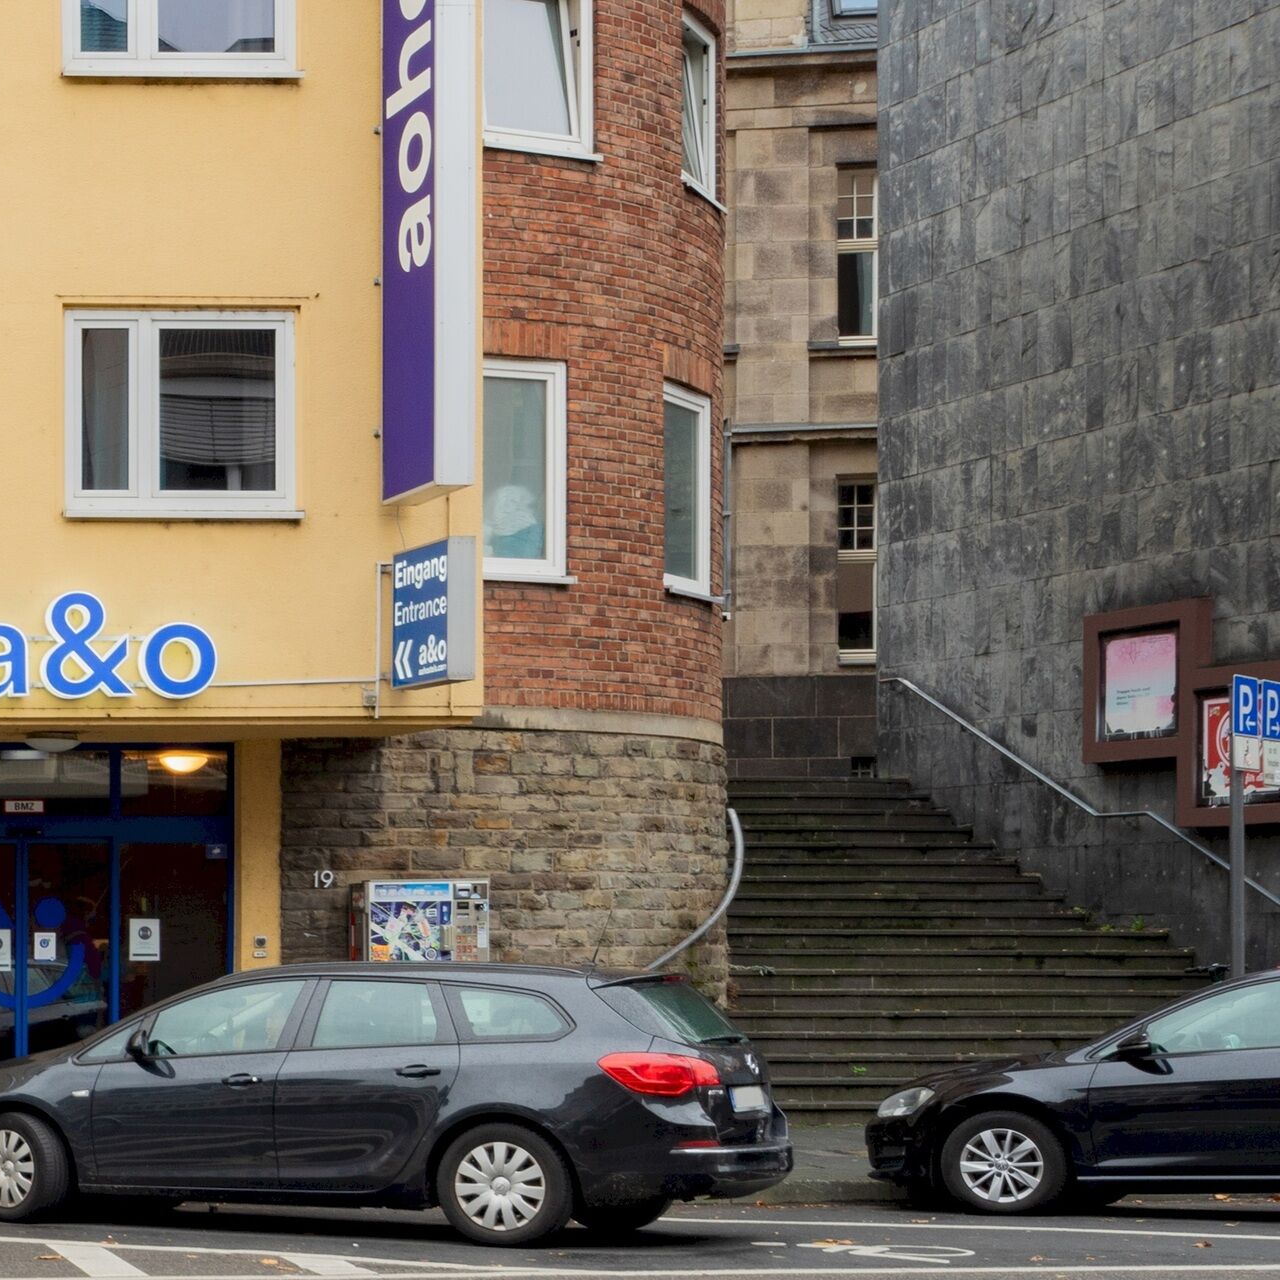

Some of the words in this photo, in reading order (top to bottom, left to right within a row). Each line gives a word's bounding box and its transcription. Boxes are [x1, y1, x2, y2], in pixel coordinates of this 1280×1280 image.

[394, 554, 448, 590] Eingang
[394, 595, 448, 627] Entrance
[418, 634, 447, 665] a&o
[14, 802, 35, 811] BMZ
[313, 870, 334, 888] 19
